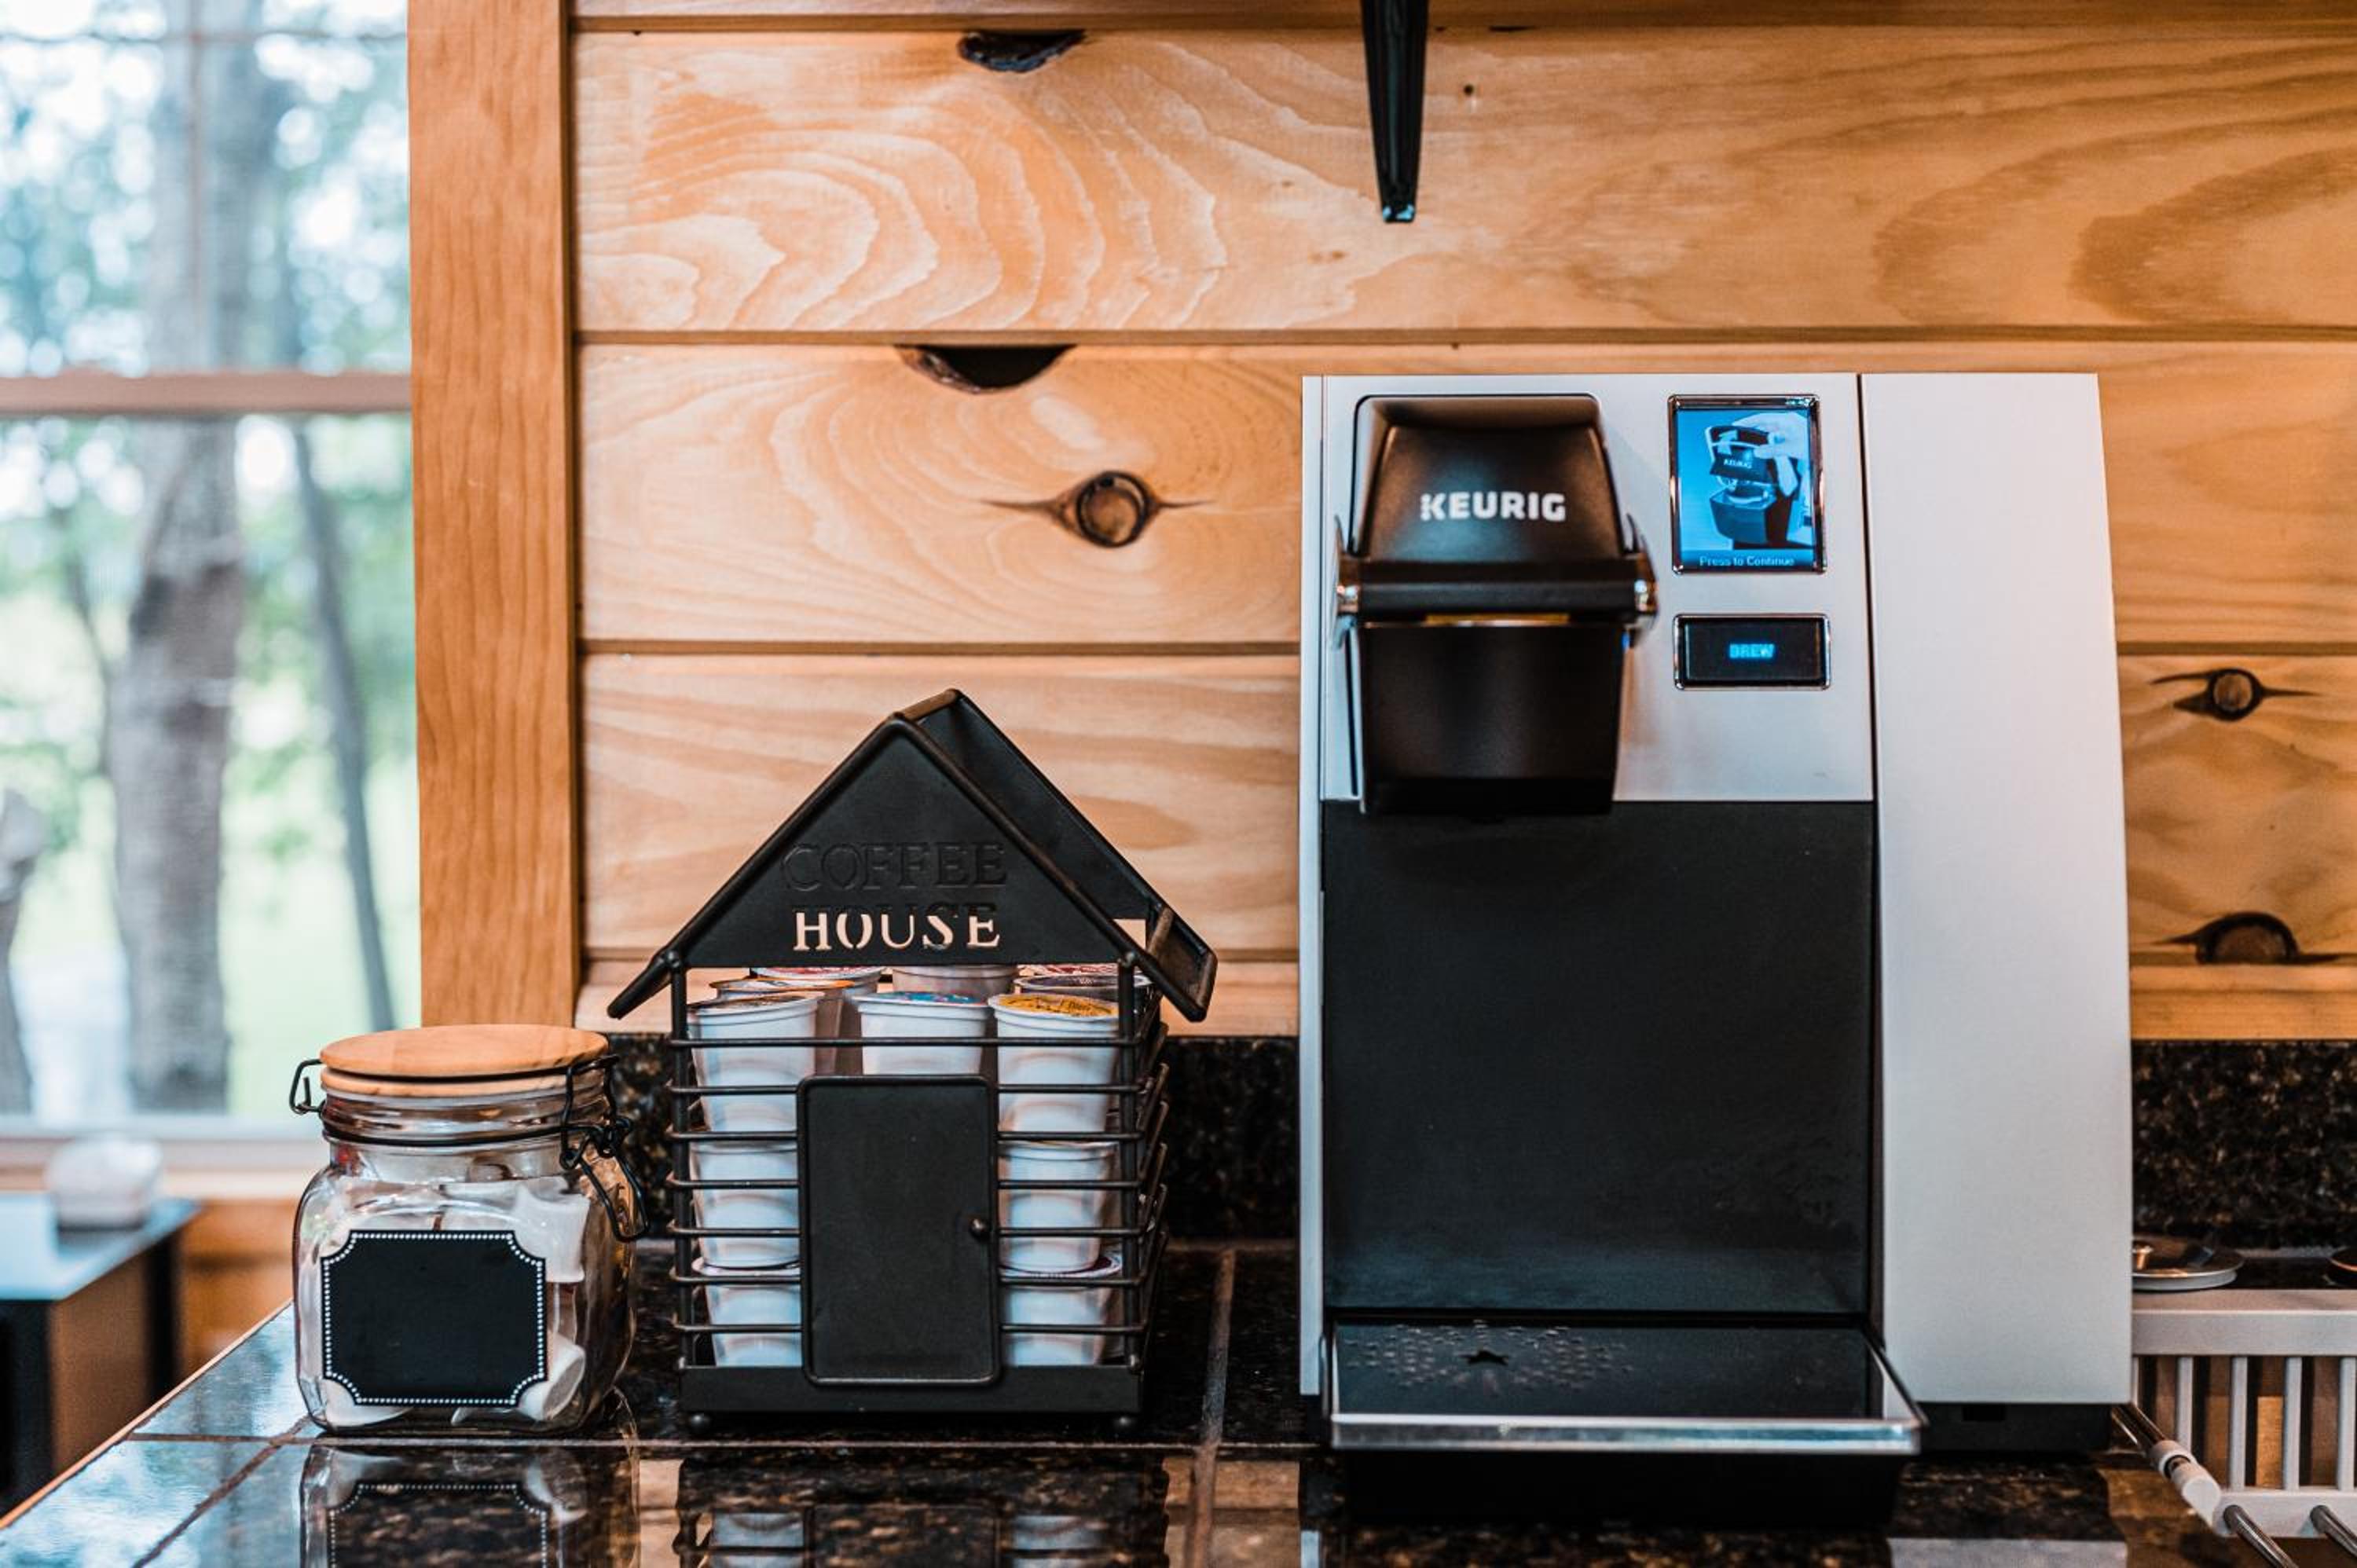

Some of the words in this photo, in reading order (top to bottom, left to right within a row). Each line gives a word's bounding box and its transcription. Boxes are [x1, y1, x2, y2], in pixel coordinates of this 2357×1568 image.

[1420, 491, 1566, 522] KEURIG
[1699, 556, 1731, 566] Press
[1733, 556, 1743, 566] to
[1747, 556, 1795, 566] Continue
[782, 842, 1007, 892] COFFEE
[792, 903, 1001, 952] HOUSE
